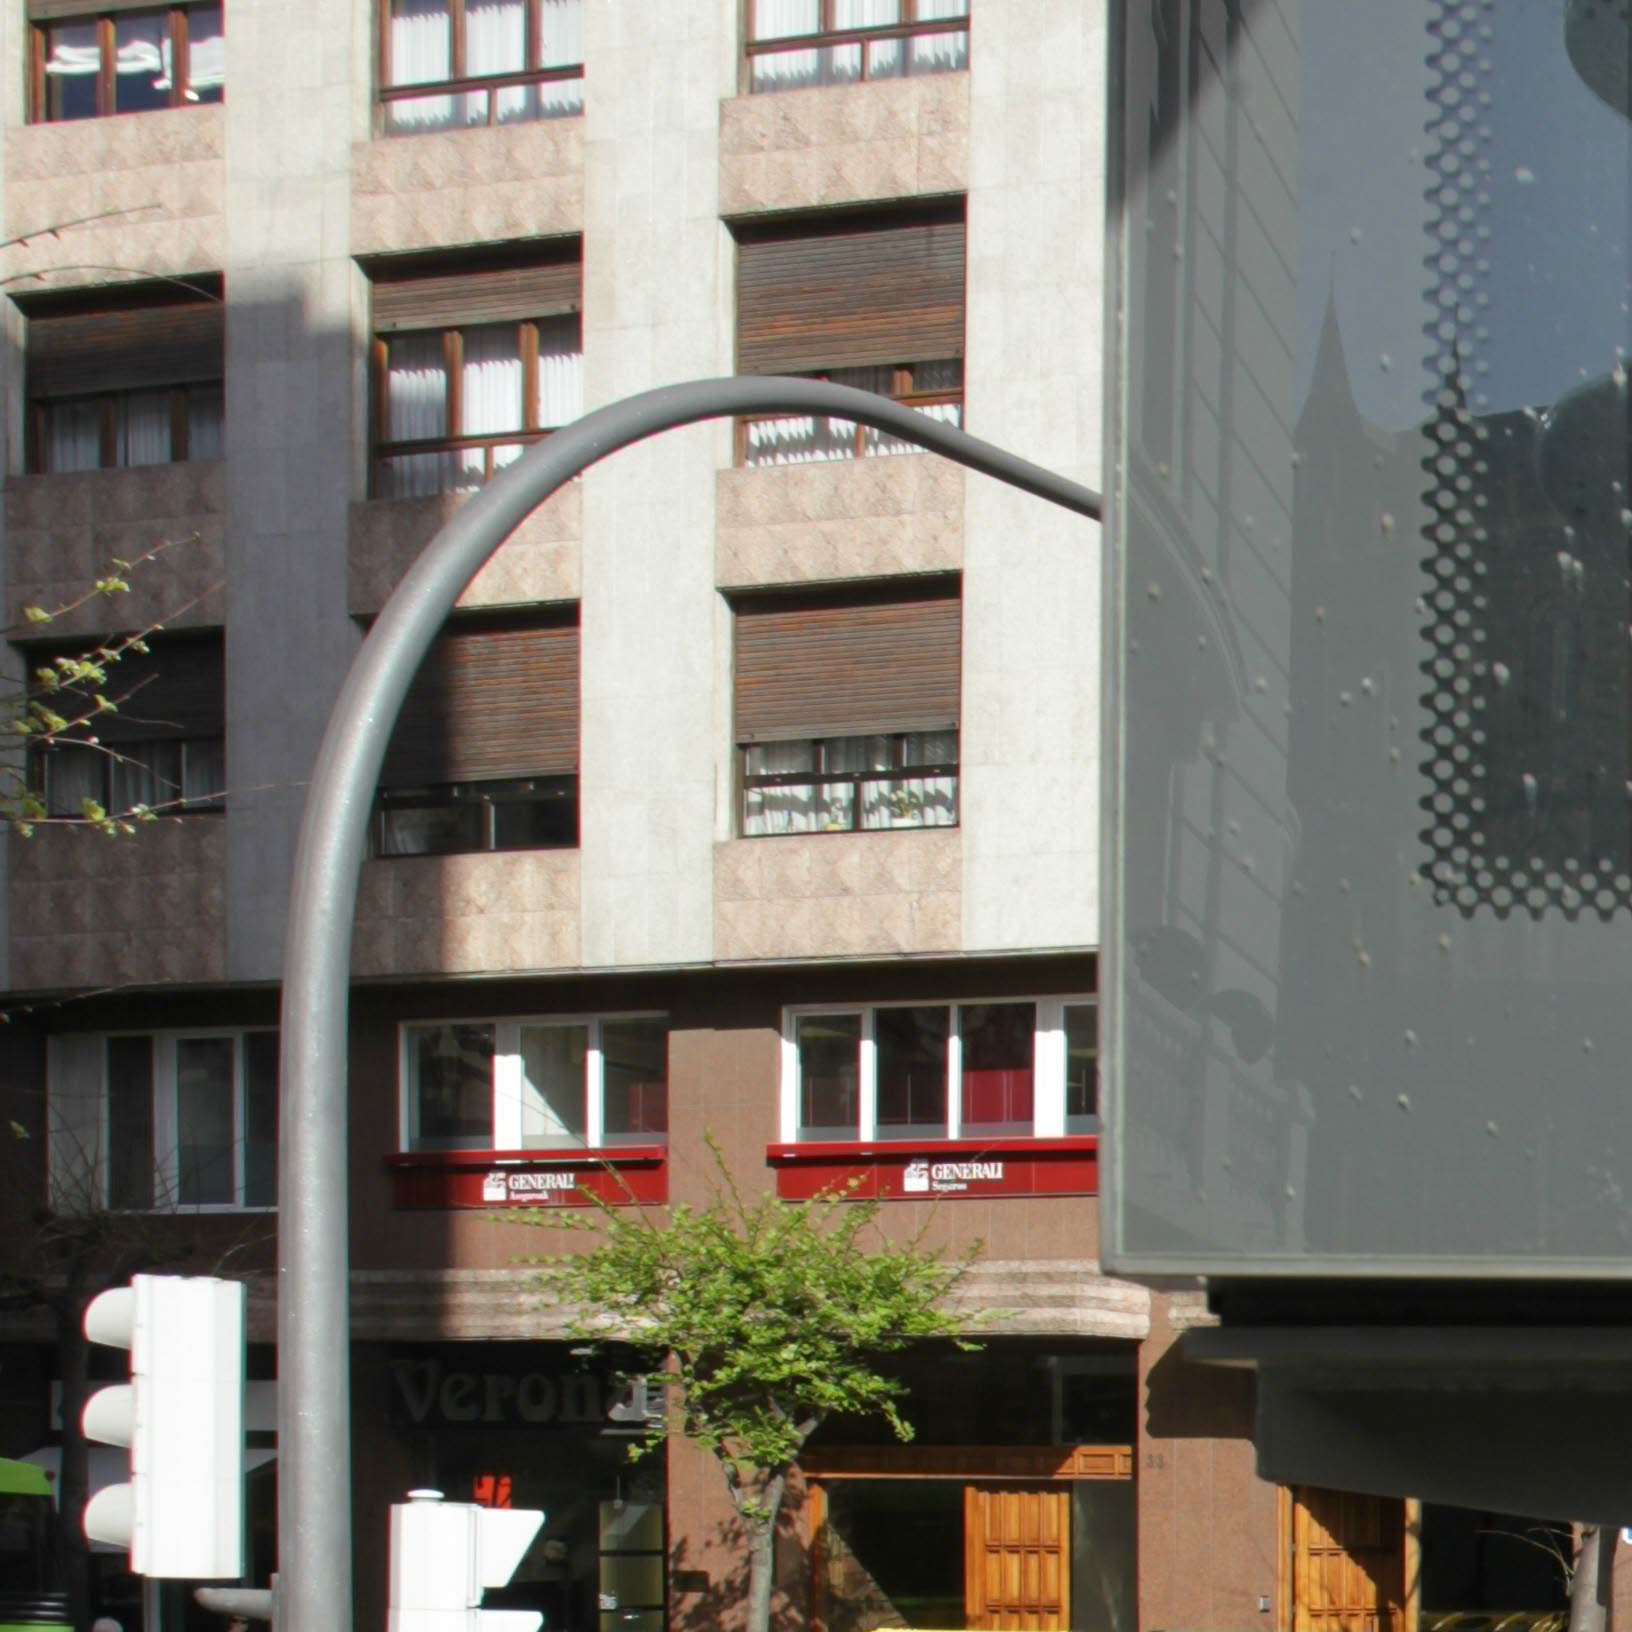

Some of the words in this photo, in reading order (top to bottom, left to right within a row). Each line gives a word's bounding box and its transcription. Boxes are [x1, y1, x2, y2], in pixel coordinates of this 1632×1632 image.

[931, 1162, 1004, 1179] GENERALI
[509, 1173, 575, 1190] GENERALI
[393, 1358, 663, 1423] Verona
